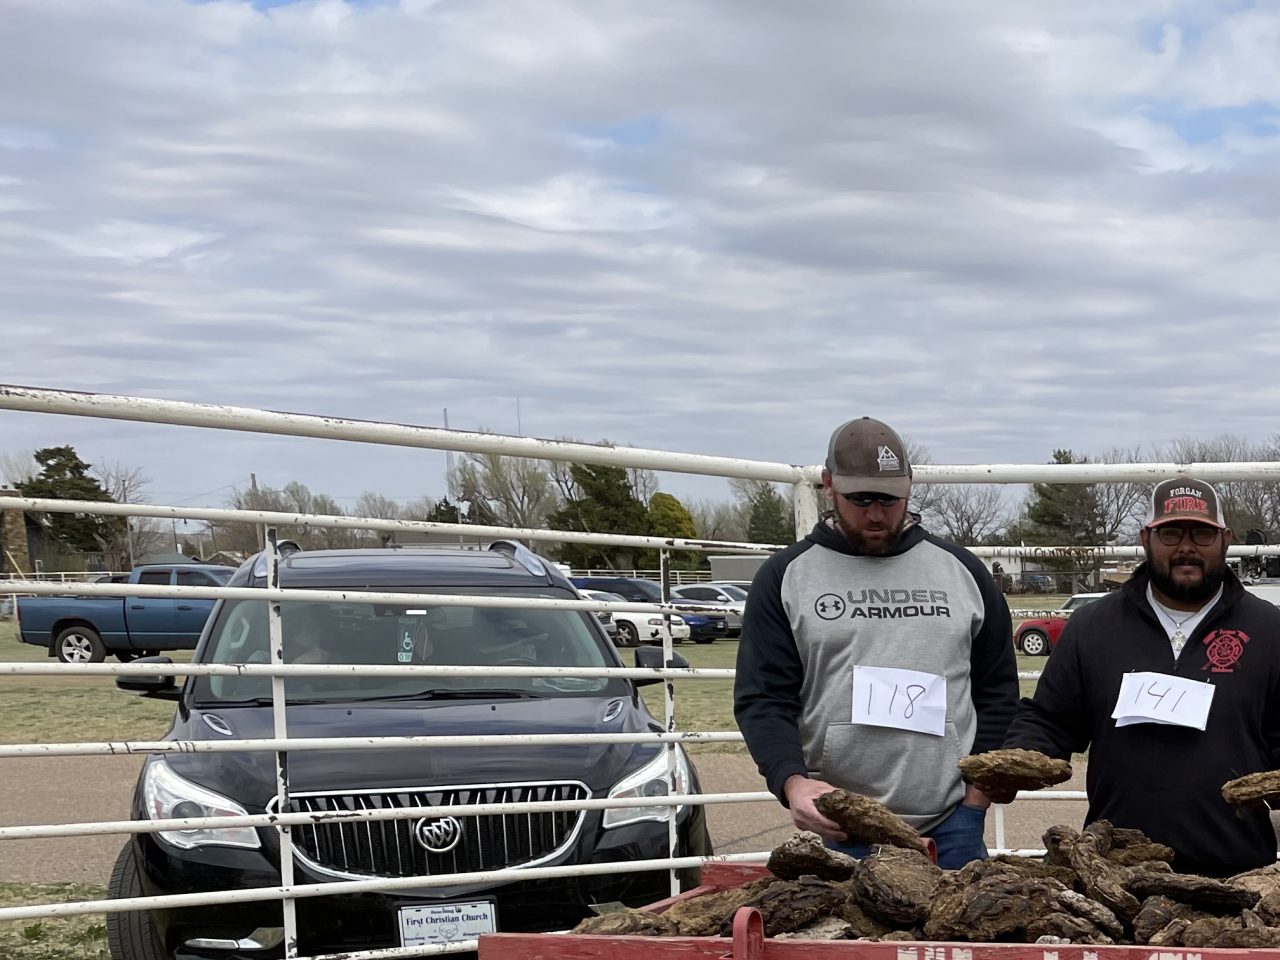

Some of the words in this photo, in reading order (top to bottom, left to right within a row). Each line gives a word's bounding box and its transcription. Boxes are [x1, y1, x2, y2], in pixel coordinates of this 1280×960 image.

[1170, 487, 1202, 498] FORGAN
[1164, 496, 1209, 514] FIRE
[847, 588, 949, 604] UNDER
[850, 605, 951, 619] ARMOUR
[867, 682, 926, 719] 118
[1134, 681, 1187, 713] 141
[406, 918, 424, 926] First
[425, 915, 460, 925] Christian
[461, 912, 488, 922] Church
